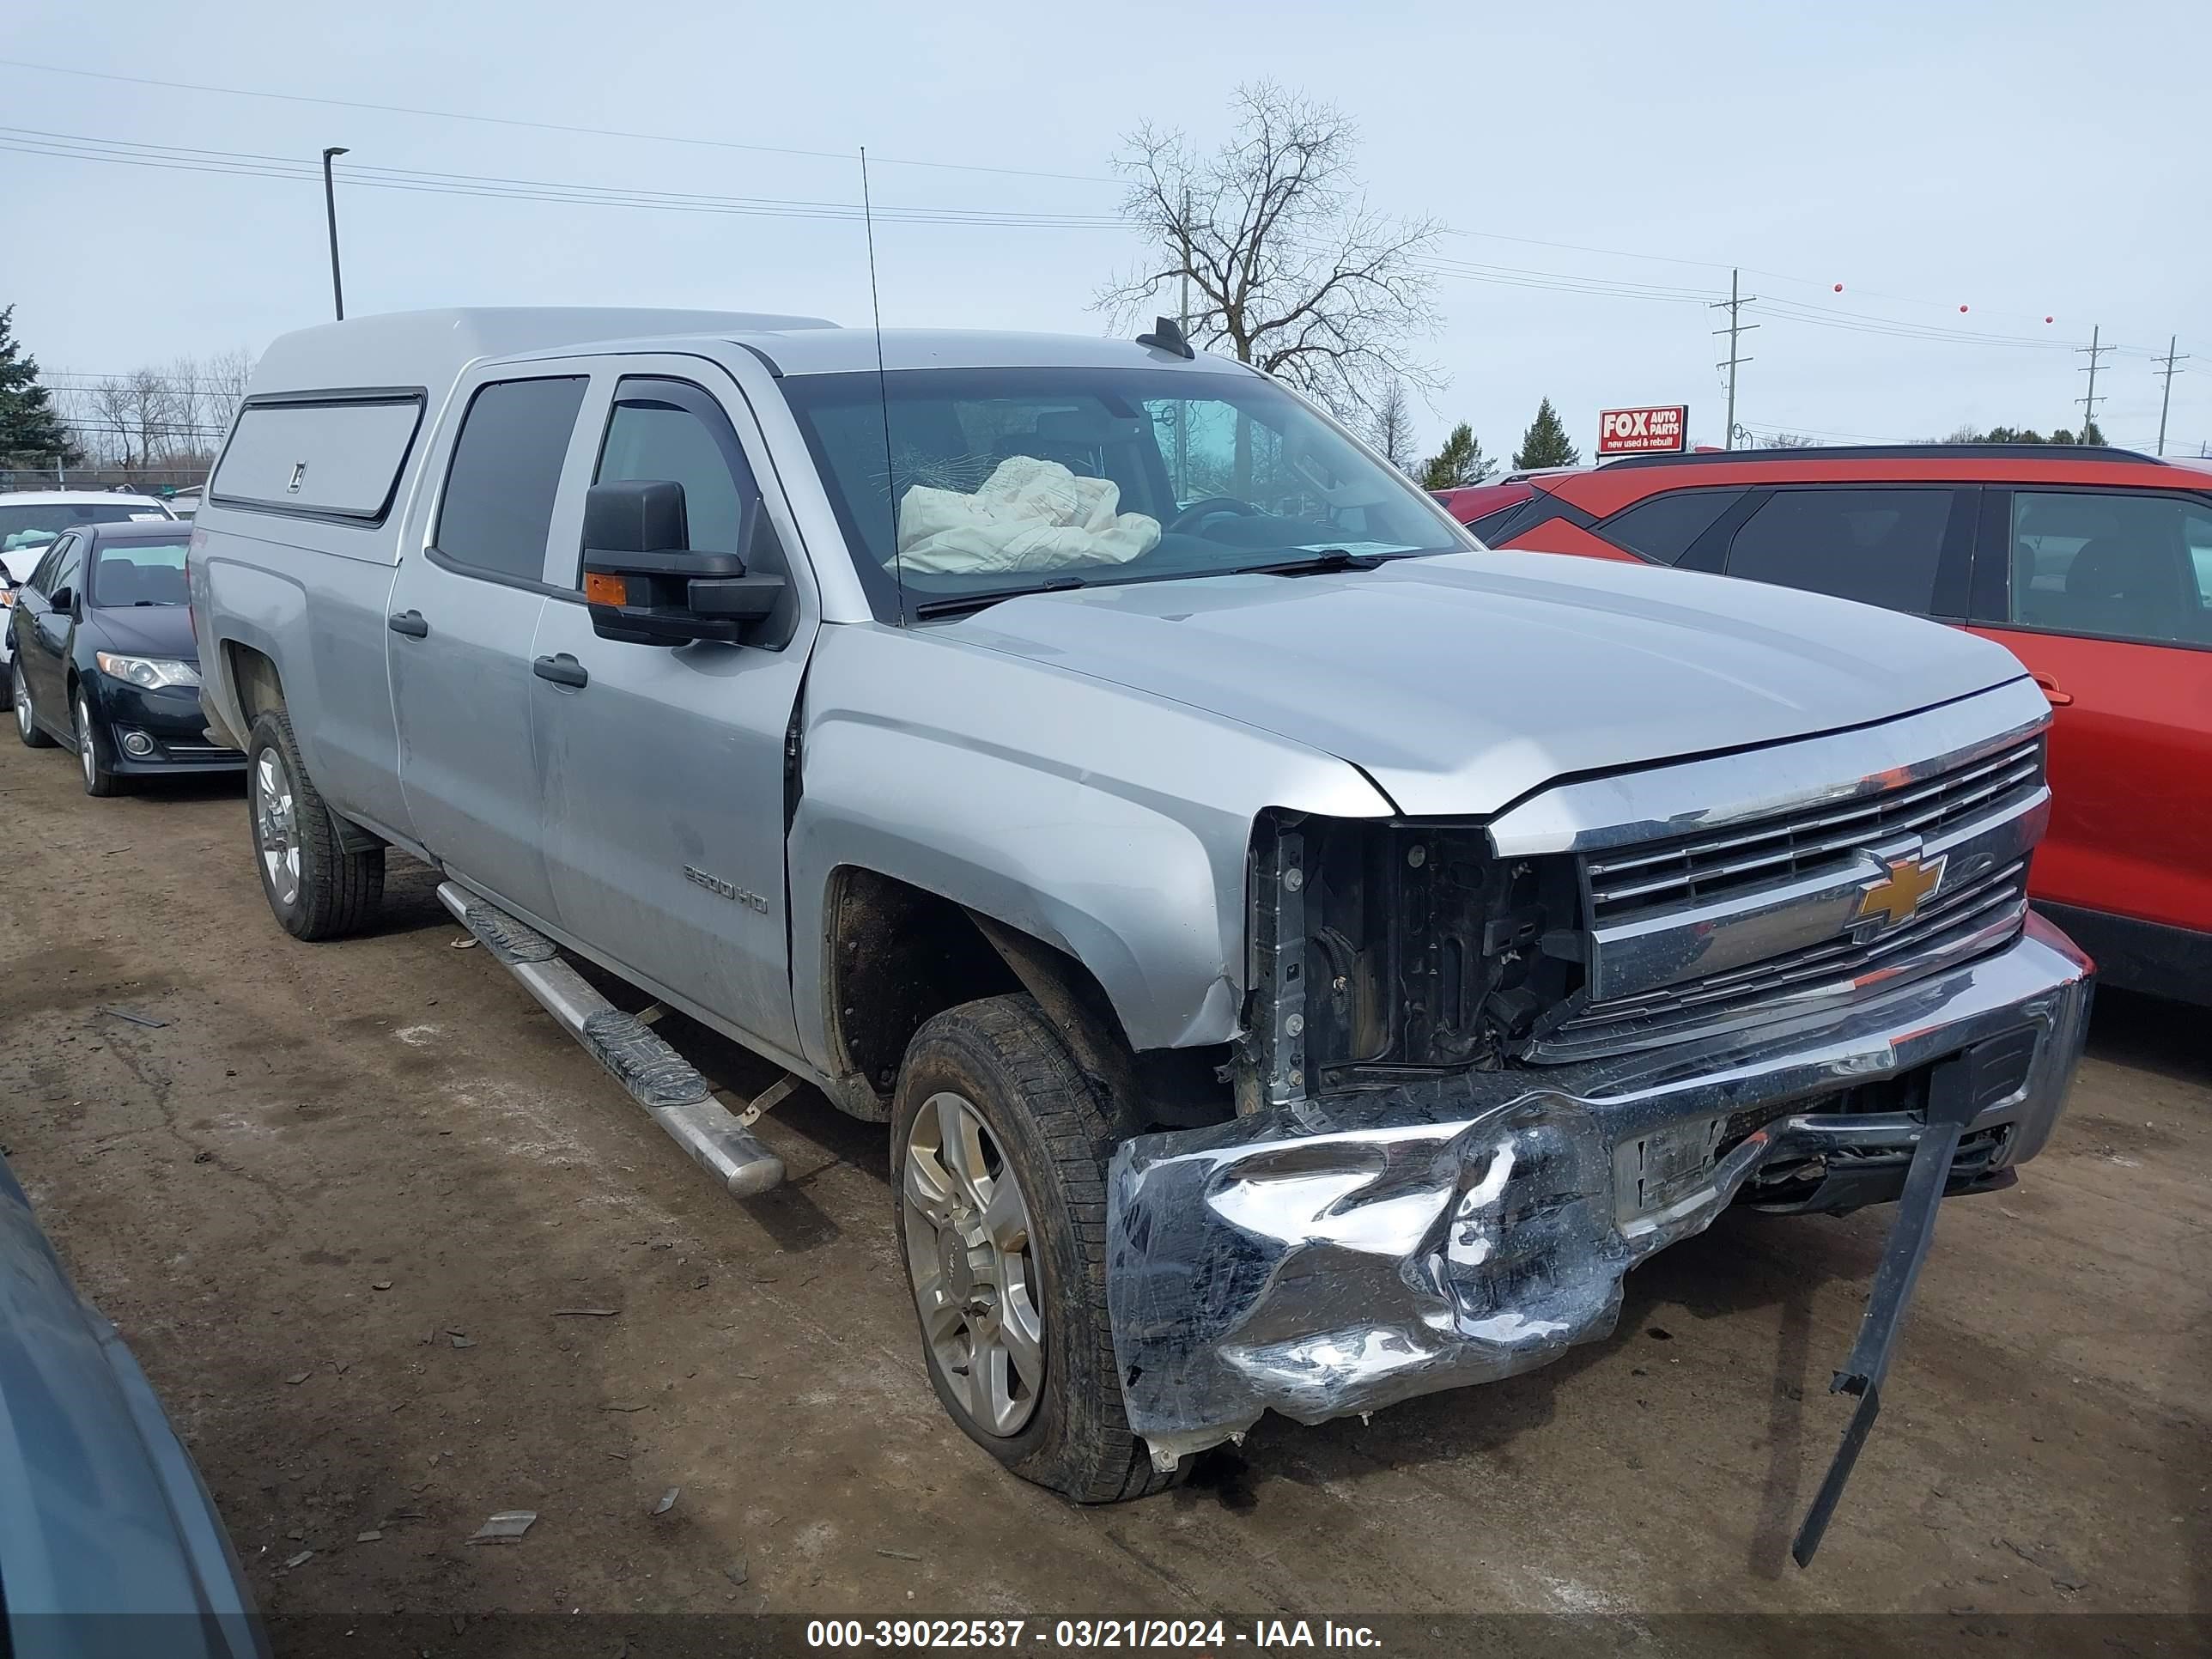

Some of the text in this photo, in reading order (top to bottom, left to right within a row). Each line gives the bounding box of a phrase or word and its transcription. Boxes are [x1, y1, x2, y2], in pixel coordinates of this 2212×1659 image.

[1650, 411, 1677, 423] AUTO
[1603, 413, 1649, 438] FOX
[1650, 423, 1680, 435] PARTS
[1607, 436, 1673, 448] new used & rebuilt
